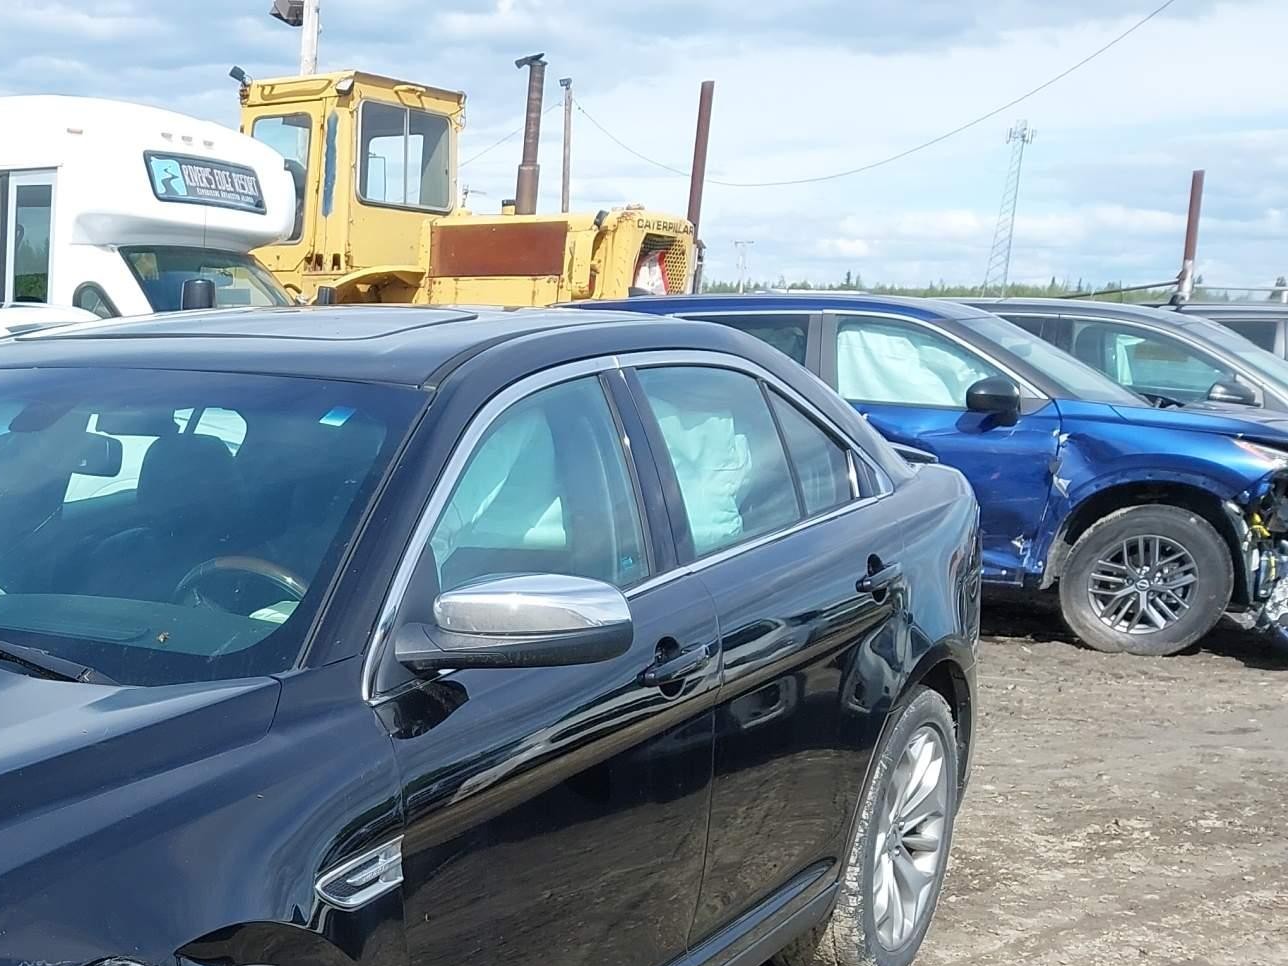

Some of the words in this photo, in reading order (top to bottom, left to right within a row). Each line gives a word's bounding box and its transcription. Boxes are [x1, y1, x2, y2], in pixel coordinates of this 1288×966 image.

[214, 169, 234, 192] EDGE
[232, 173, 259, 197] RESORT
[637, 218, 694, 236] CATERPILLAR
